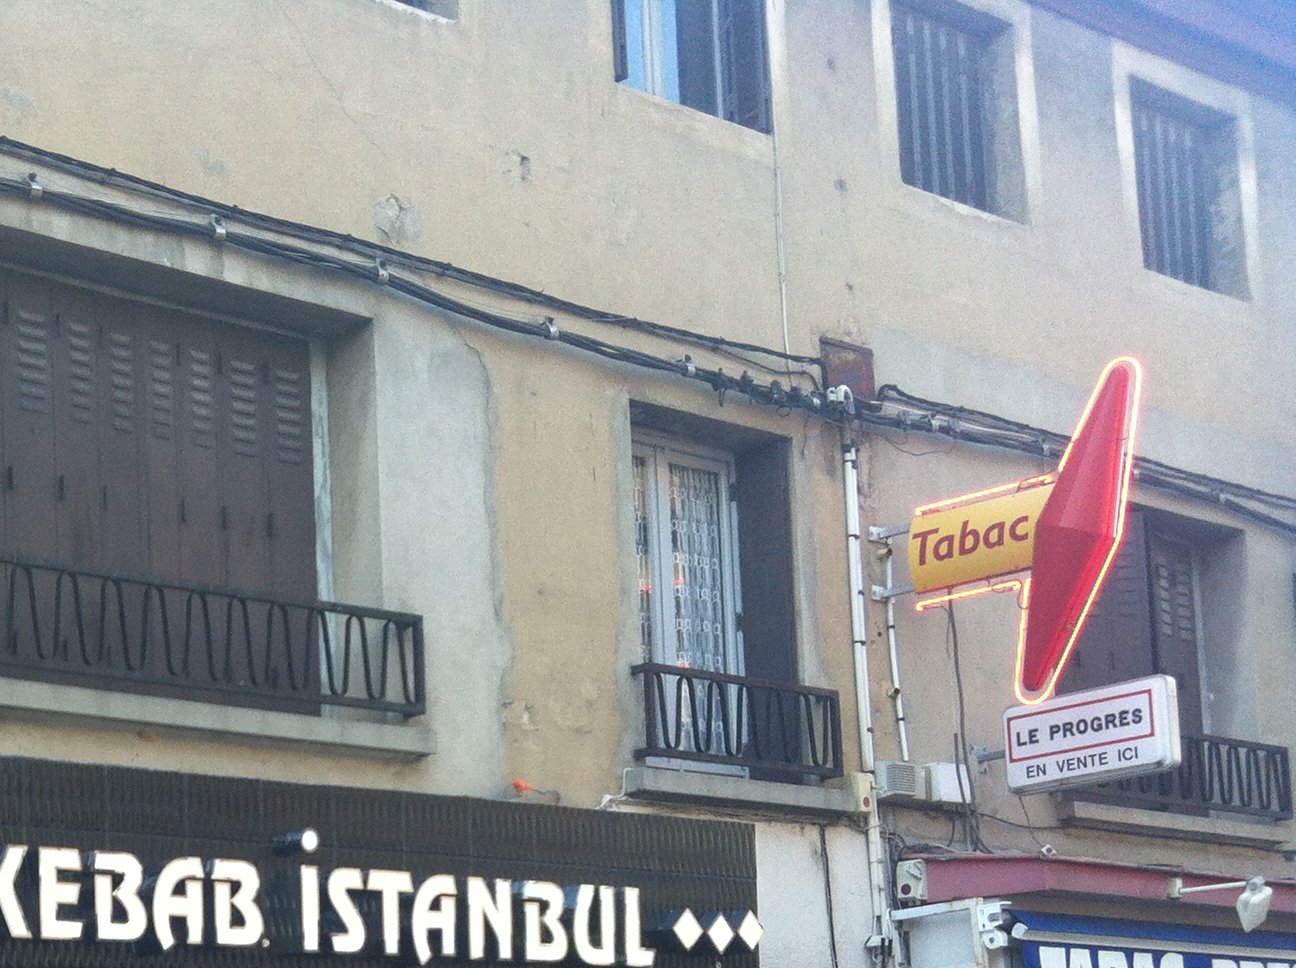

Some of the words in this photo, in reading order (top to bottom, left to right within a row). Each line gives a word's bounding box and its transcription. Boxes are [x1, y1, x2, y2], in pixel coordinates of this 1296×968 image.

[912, 514, 1029, 567] Tabac
[1016, 729, 1039, 747] LE
[1026, 763, 1047, 779] EN
[1056, 751, 1108, 773] VENTE
[1117, 746, 1139, 762] ICI
